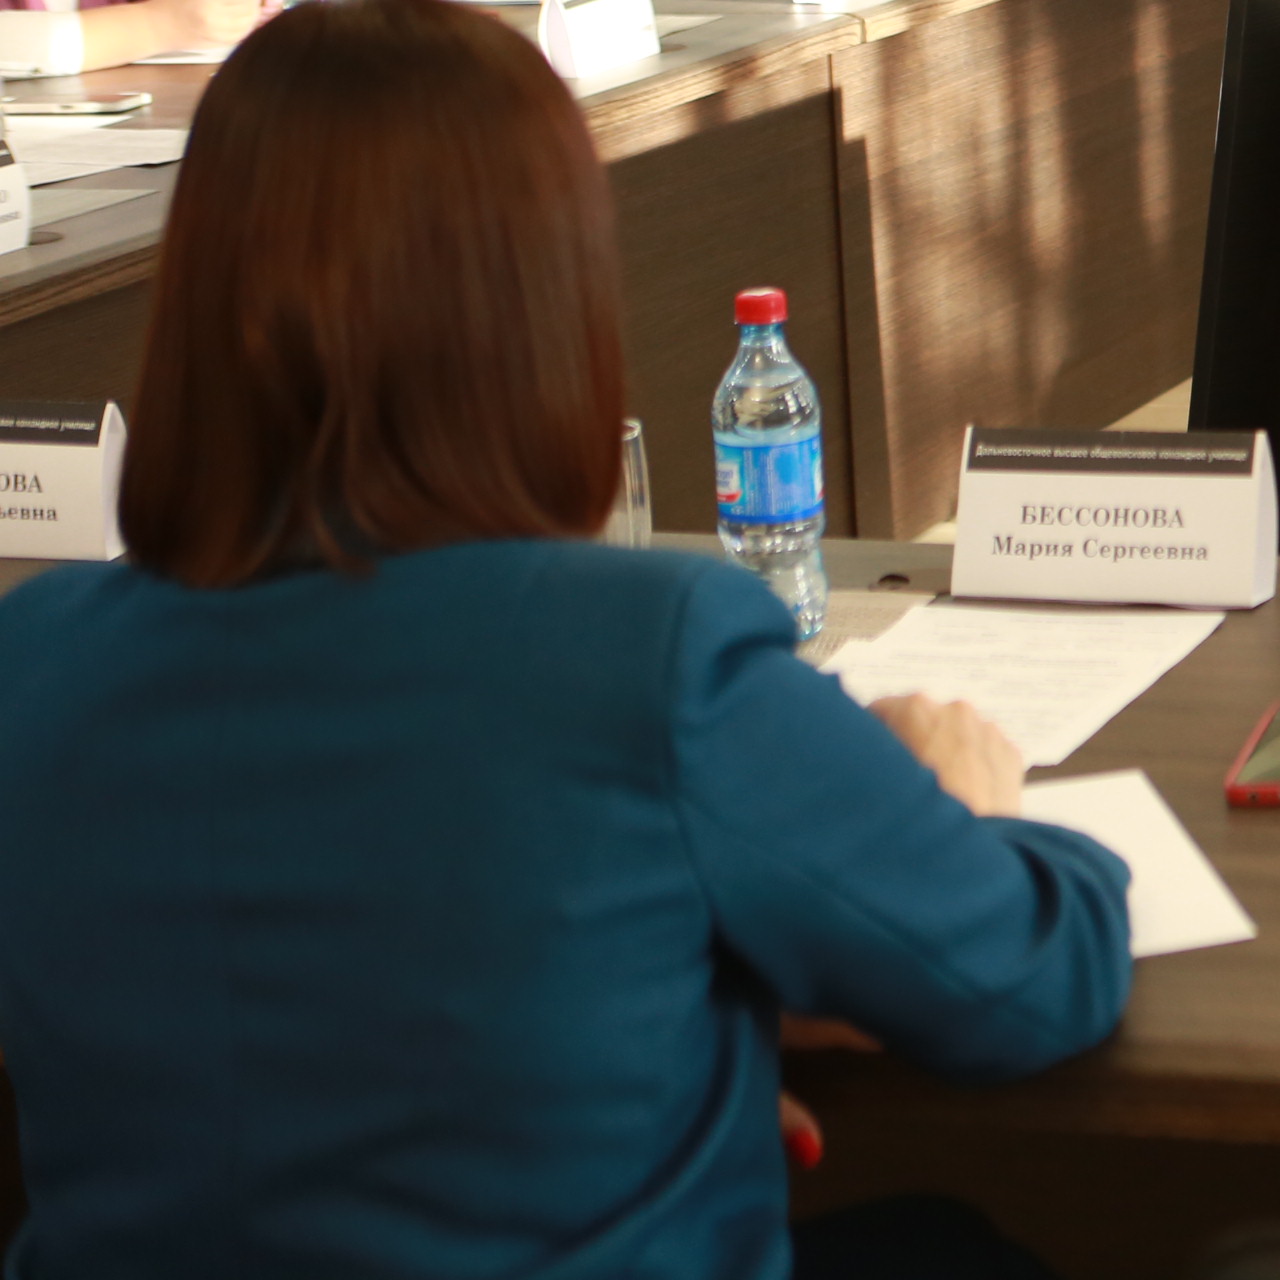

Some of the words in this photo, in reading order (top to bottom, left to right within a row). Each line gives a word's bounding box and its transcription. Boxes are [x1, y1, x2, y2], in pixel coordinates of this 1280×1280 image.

[976, 444, 1051, 458] Дальневосточное
[1020, 504, 1185, 529] БЕССОНОВА
[992, 535, 1073, 561] Мария
[1081, 538, 1209, 563] Сергеевна
